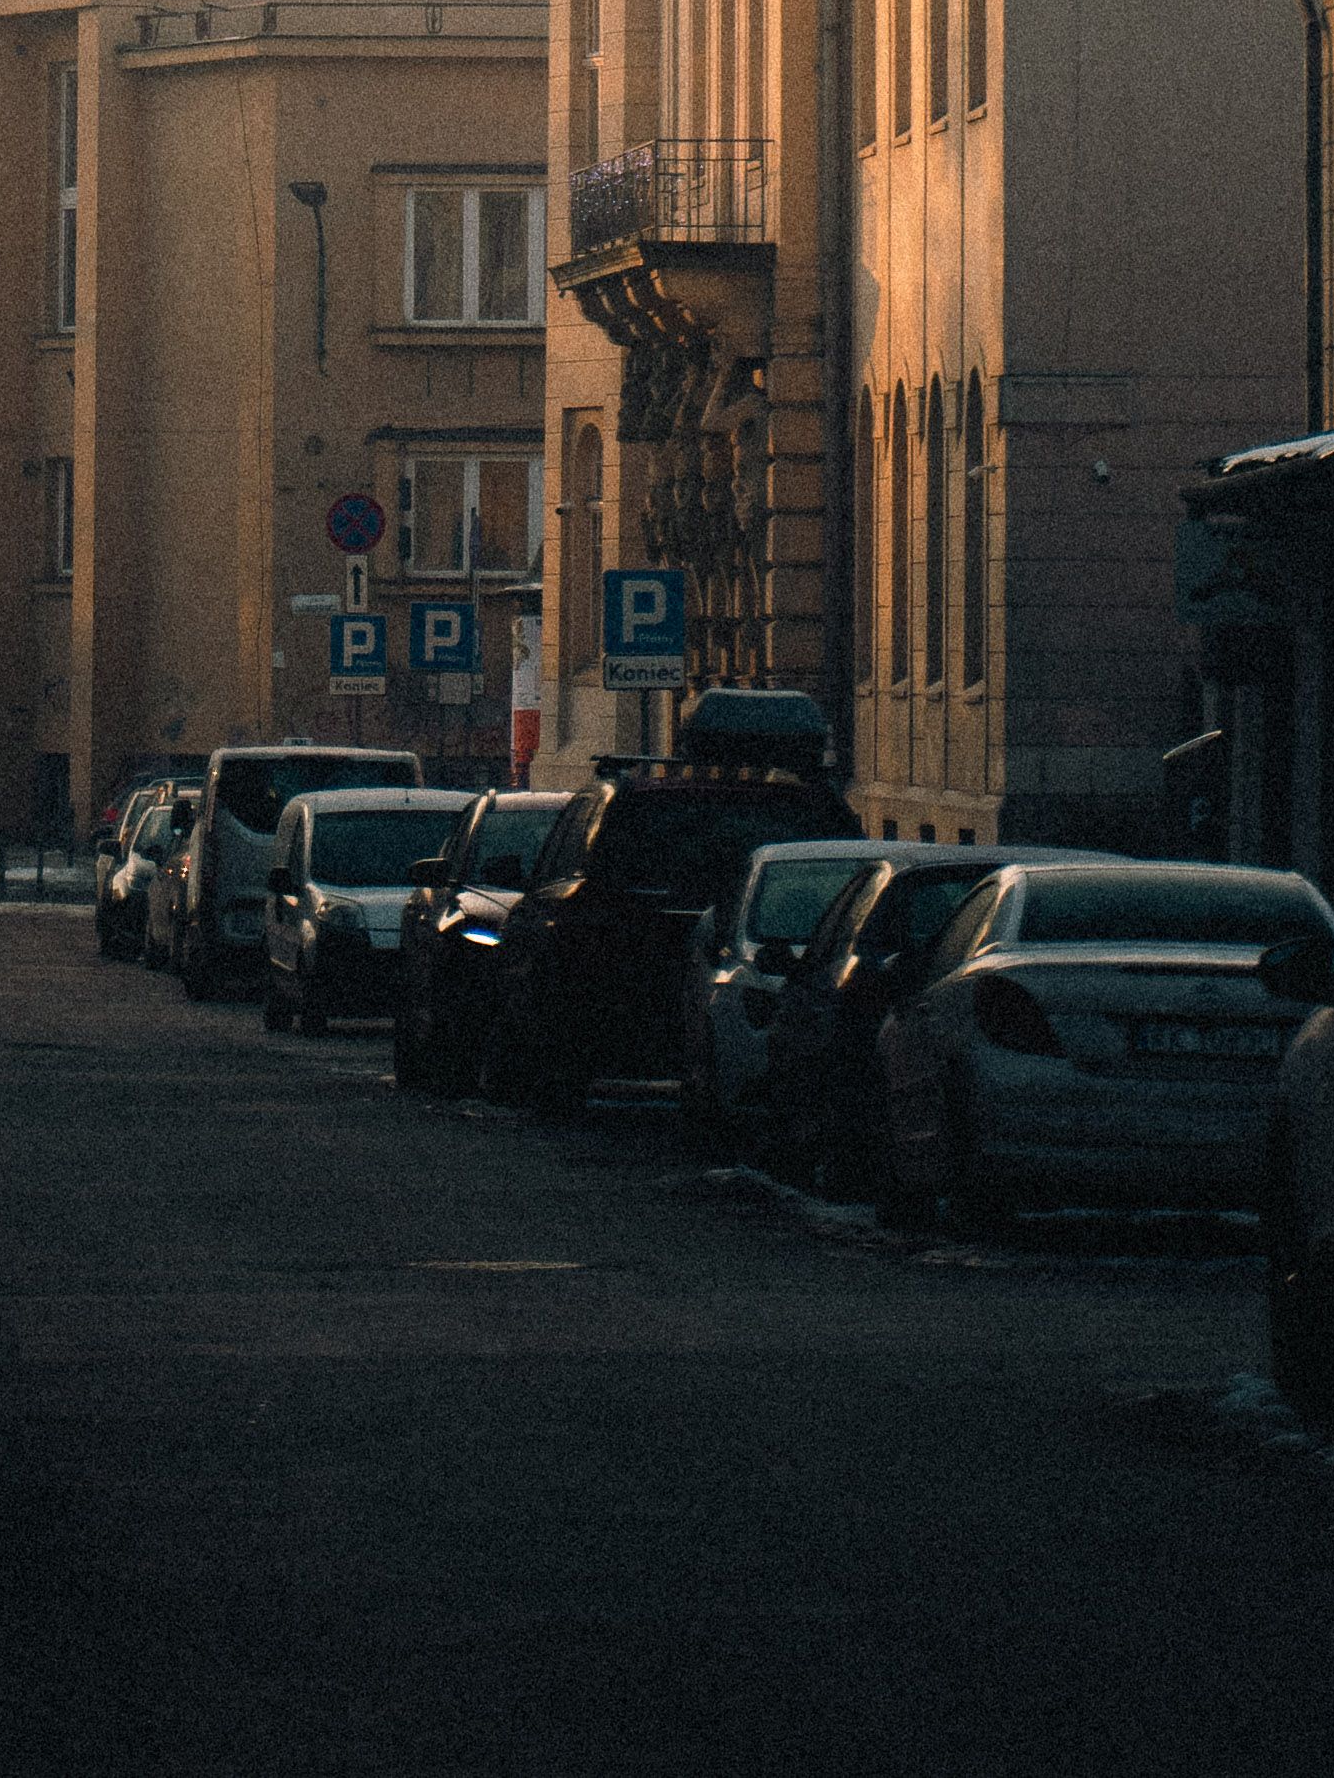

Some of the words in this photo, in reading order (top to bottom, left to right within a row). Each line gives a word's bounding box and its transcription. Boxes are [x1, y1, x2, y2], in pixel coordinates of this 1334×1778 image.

[622, 579, 667, 644] P
[342, 621, 376, 668] P
[423, 610, 461, 662] P
[335, 679, 380, 692] Koniec
[608, 662, 681, 682] Koniec
